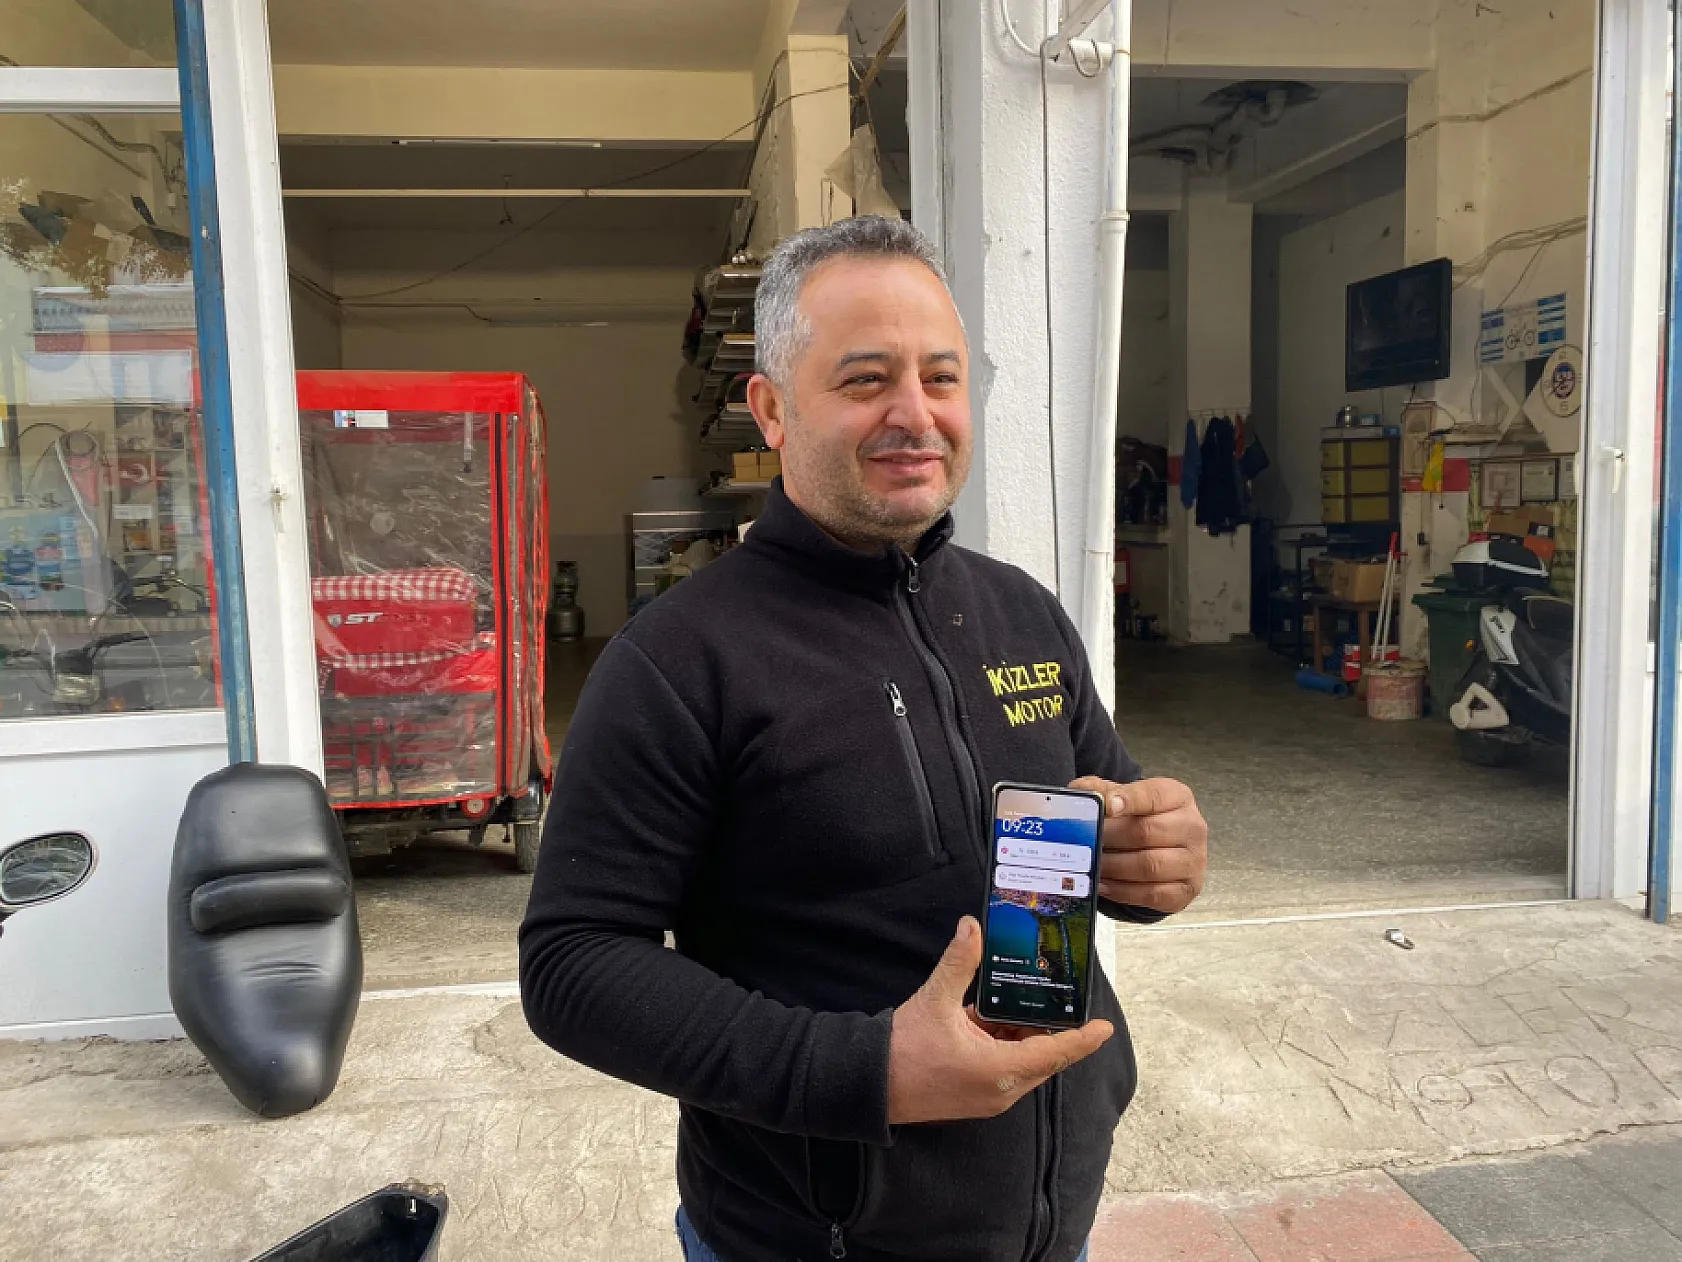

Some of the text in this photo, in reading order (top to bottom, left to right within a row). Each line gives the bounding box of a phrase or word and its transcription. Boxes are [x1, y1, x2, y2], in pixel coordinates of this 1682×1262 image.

[982, 660, 1061, 696] İKİZLER
[1002, 694, 1064, 727] MOTOR
[1001, 819, 1044, 836] 09:23
